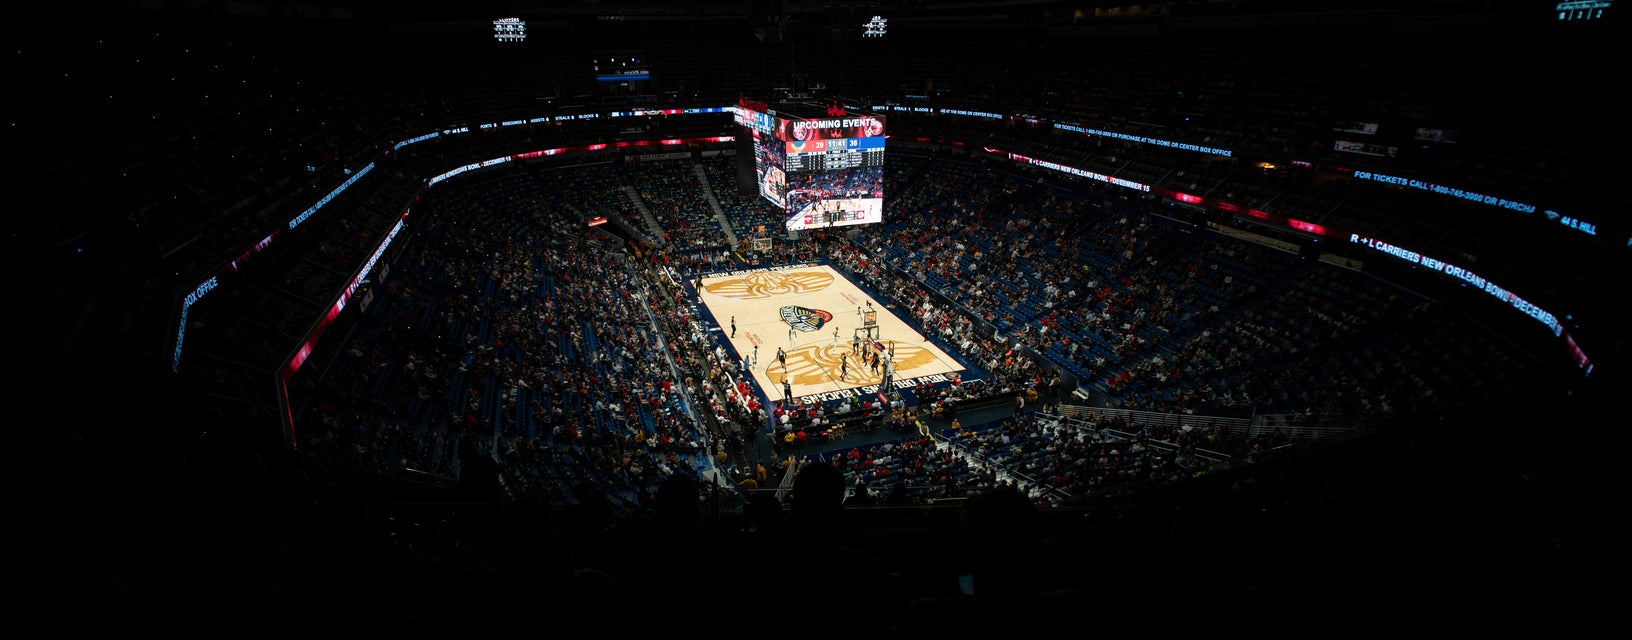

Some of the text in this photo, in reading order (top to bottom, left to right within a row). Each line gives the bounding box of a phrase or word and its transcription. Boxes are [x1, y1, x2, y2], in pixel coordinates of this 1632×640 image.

[793, 118, 876, 130] UPCOMING EVENTS
[1118, 133, 1140, 142] PURCHASE
[1179, 143, 1199, 152] CENTER
[1212, 148, 1232, 157] OFFICE
[1039, 160, 1060, 170] CARRIERS
[1060, 165, 1071, 173] NEW
[1071, 168, 1094, 179] ORLEANS
[1094, 174, 1108, 182] BOWL
[1112, 177, 1142, 190] DECEMBER
[1354, 171, 1371, 180] FOR
[1372, 174, 1408, 186] TICKETS
[1409, 180, 1428, 190] CALL
[1484, 196, 1498, 206] OR
[1560, 216, 1596, 235] 44 S. HILL
[1350, 234, 1359, 243] R
[1368, 238, 1374, 247] L
[1375, 241, 1420, 263] CARRIERS
[1421, 256, 1445, 271] NEW
[1446, 265, 1486, 289] ORLEANS
[1485, 282, 1508, 302] BOWL
[196, 276, 218, 298] OFFICE
